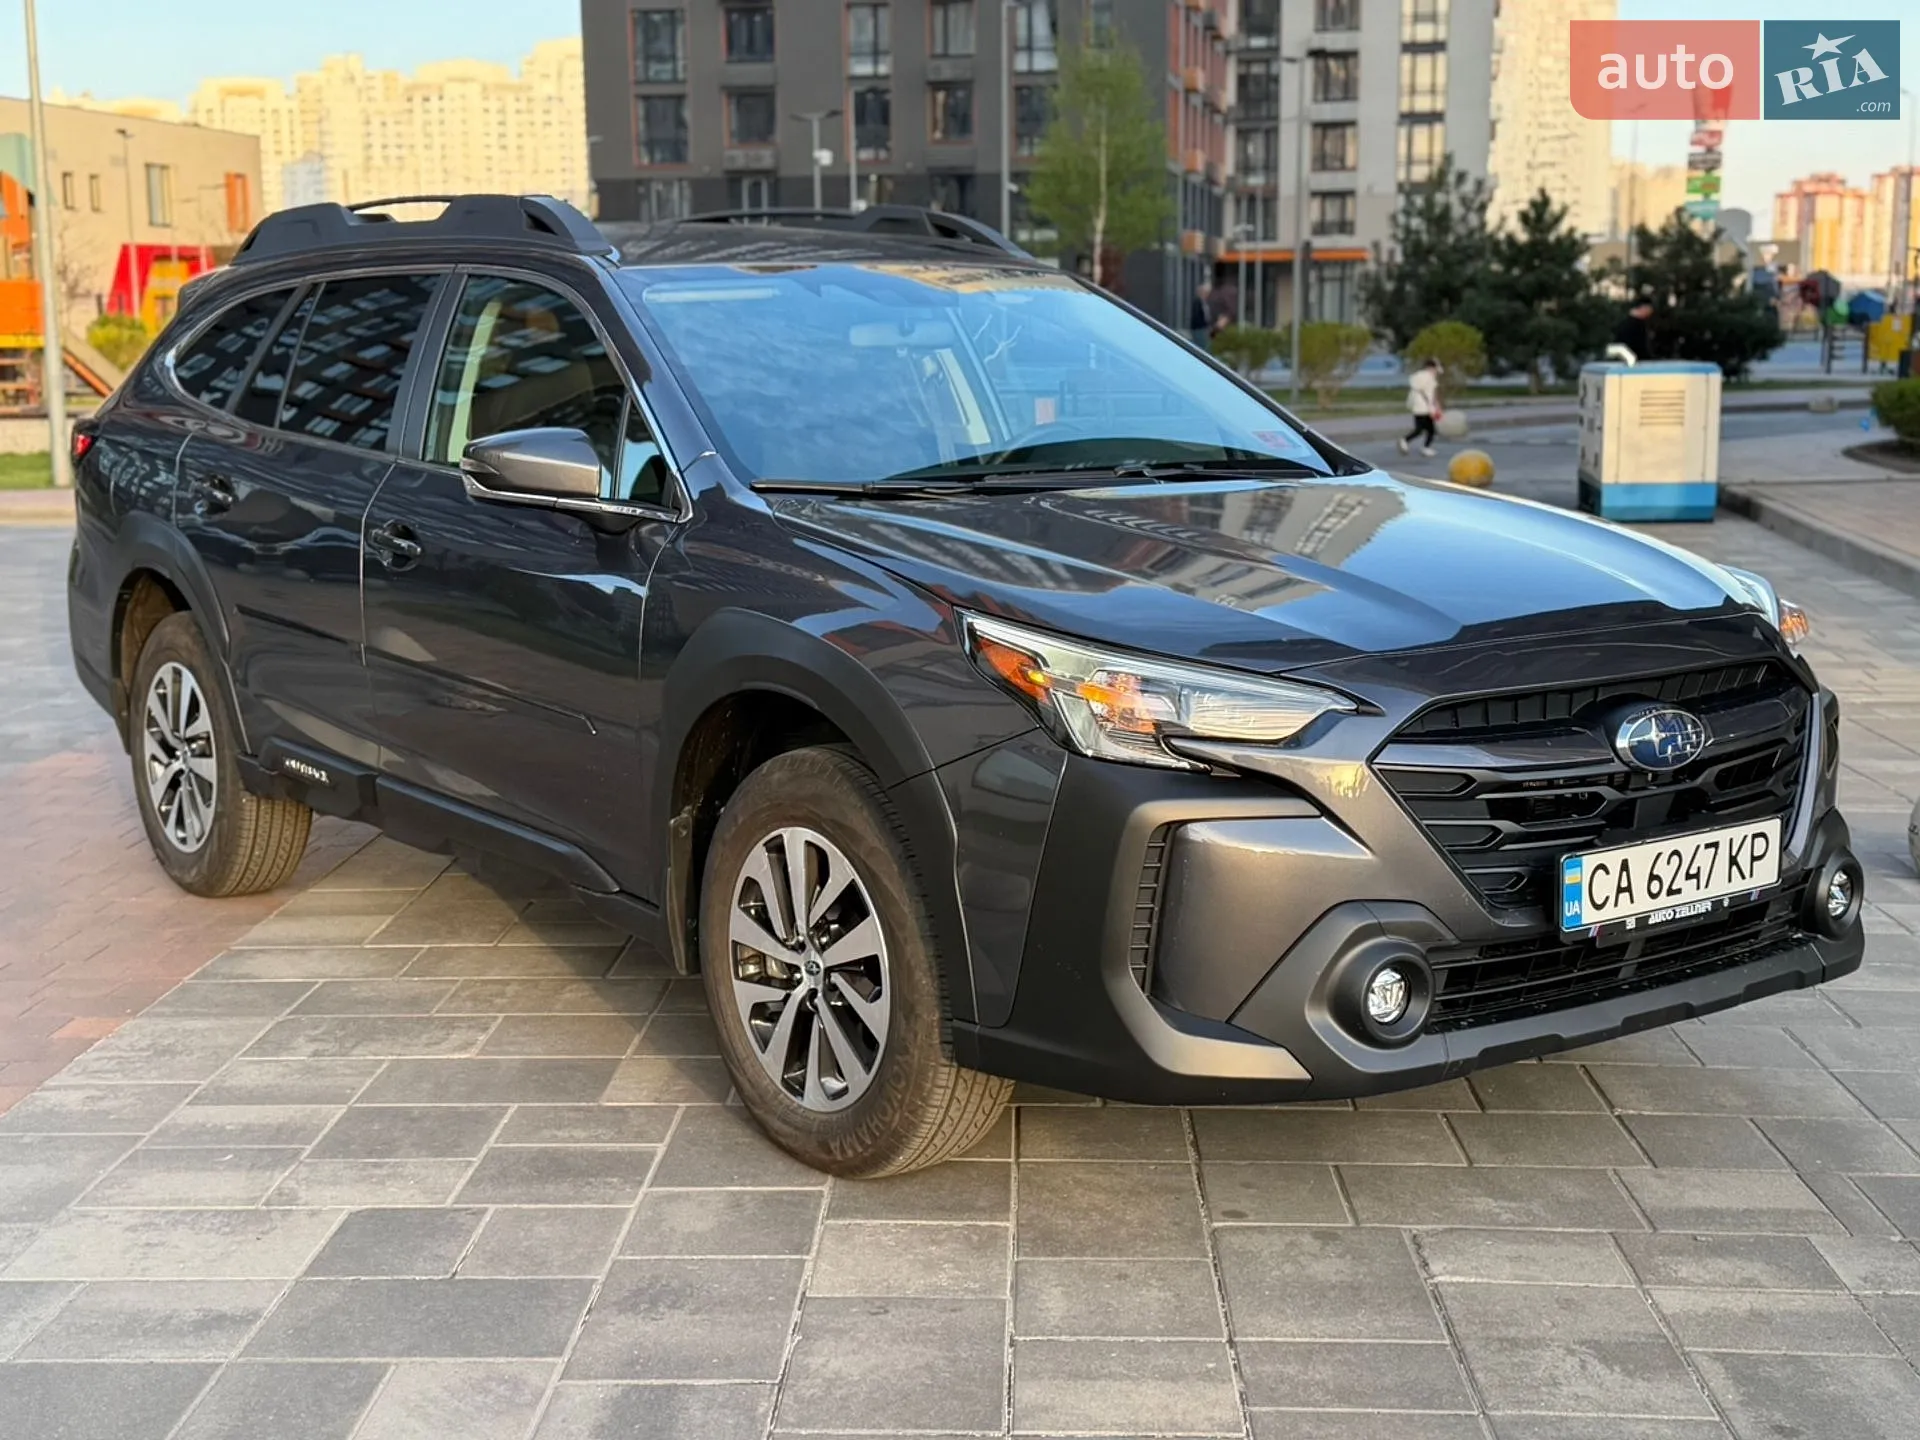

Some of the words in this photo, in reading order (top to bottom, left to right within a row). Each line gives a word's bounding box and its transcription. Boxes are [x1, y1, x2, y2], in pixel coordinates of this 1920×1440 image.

[1587, 858, 1635, 911] CA
[1646, 840, 1720, 900] 6247
[1728, 831, 1770, 884] KP
[1565, 901, 1581, 917] UA
